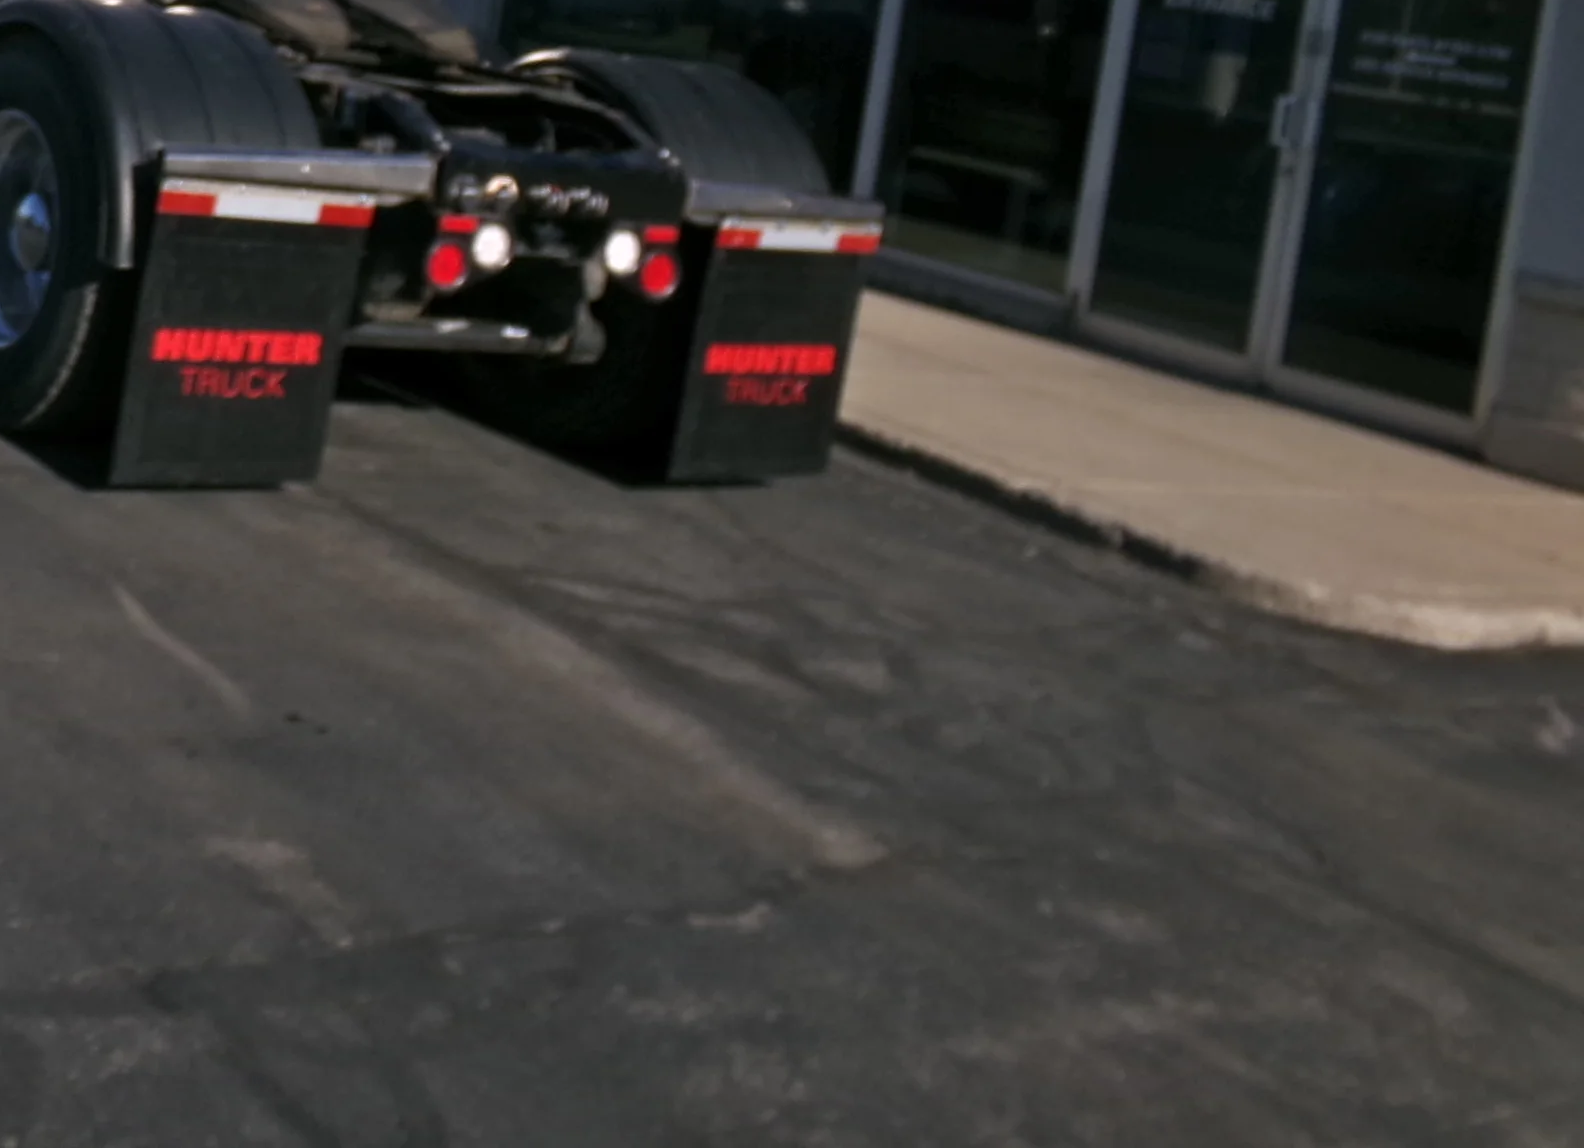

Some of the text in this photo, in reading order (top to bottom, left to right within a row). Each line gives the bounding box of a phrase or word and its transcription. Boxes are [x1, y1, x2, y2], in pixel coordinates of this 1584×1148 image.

[150, 327, 324, 367] HUNTER
[703, 342, 837, 376] HUNTER
[180, 365, 289, 400] TRUCK
[724, 376, 813, 406] TRUCK
